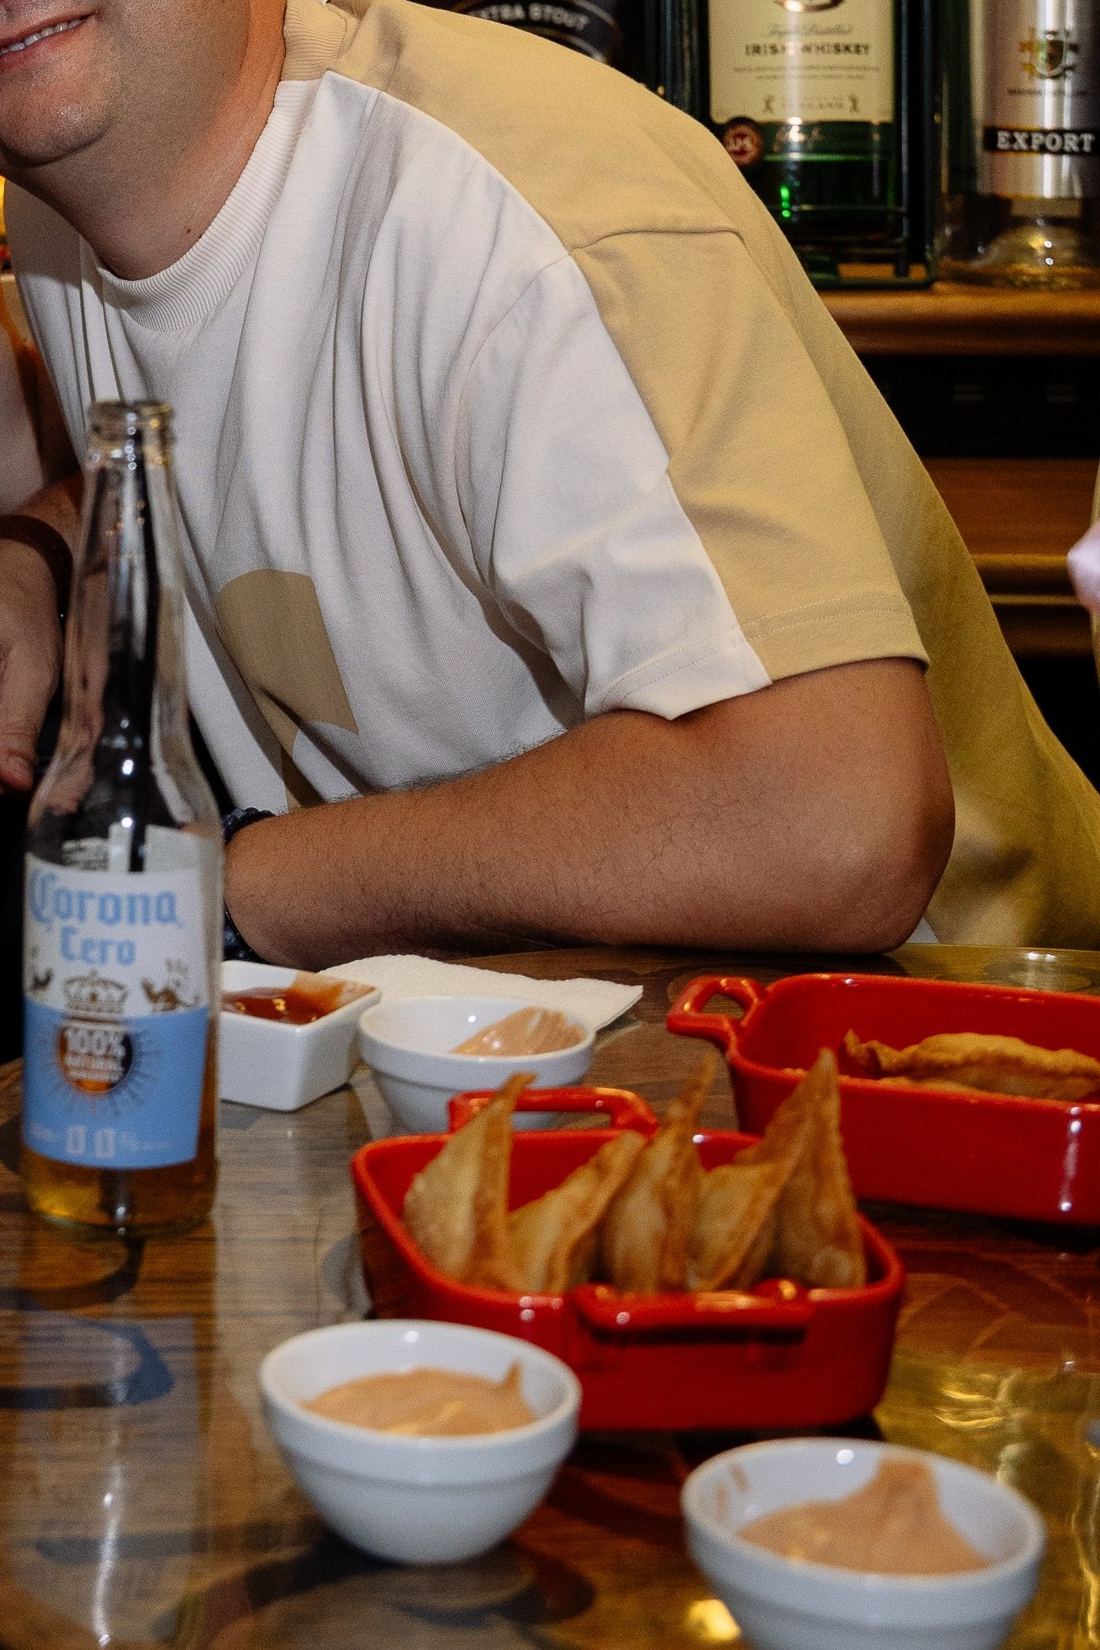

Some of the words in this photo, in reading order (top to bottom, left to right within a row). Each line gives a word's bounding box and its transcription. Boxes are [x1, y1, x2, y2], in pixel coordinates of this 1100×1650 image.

[468, 3, 526, 22] XTRA
[996, 129, 1096, 153] EXPORT
[29, 867, 184, 931] Corona
[60, 925, 137, 967] Cero
